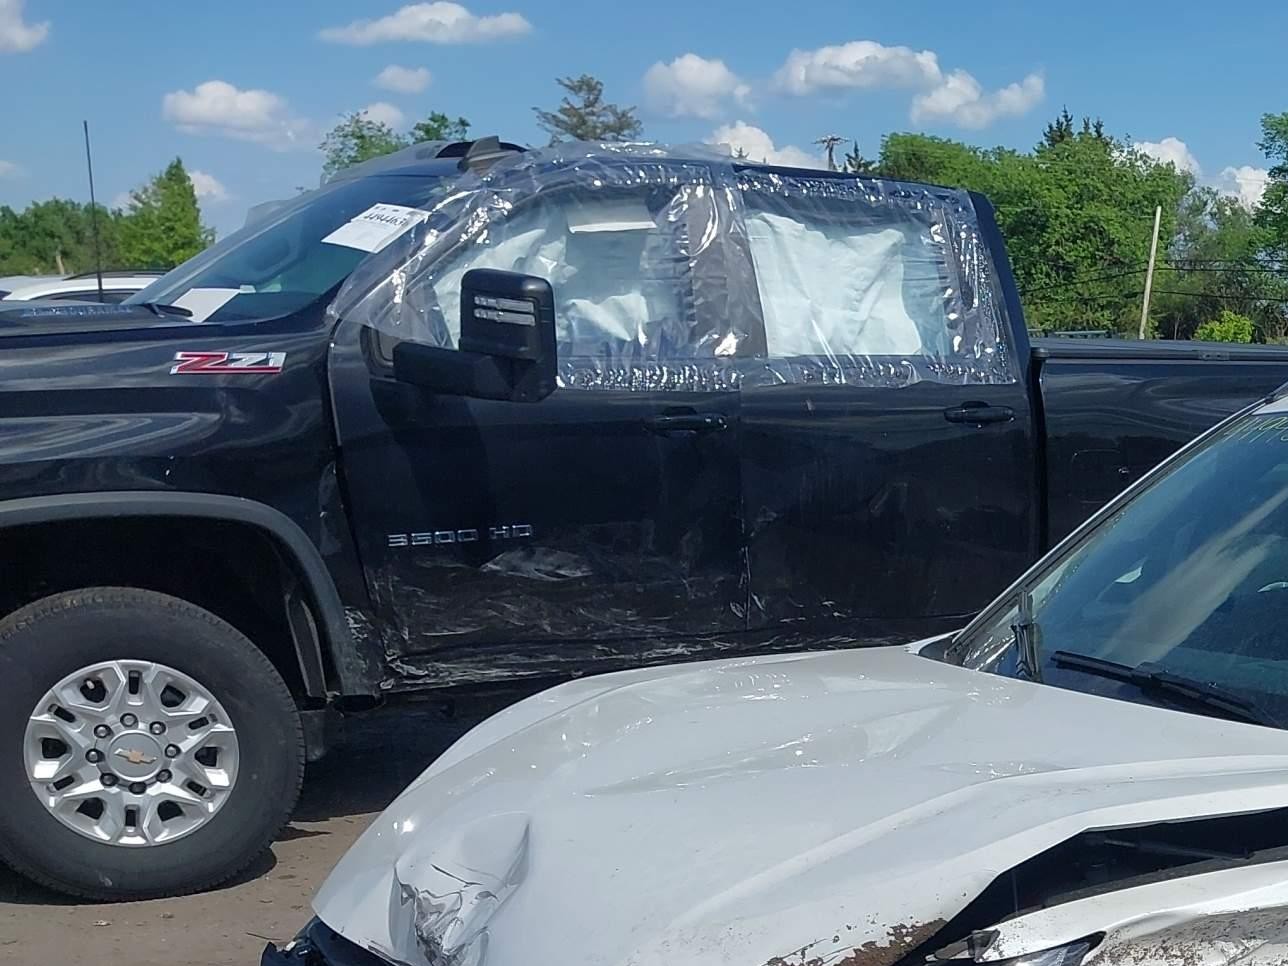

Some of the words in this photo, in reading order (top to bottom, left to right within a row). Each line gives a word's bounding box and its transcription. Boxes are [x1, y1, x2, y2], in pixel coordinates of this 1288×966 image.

[170, 351, 287, 375] Z71
[387, 529, 479, 547] 3500
[489, 524, 533, 540] HD
